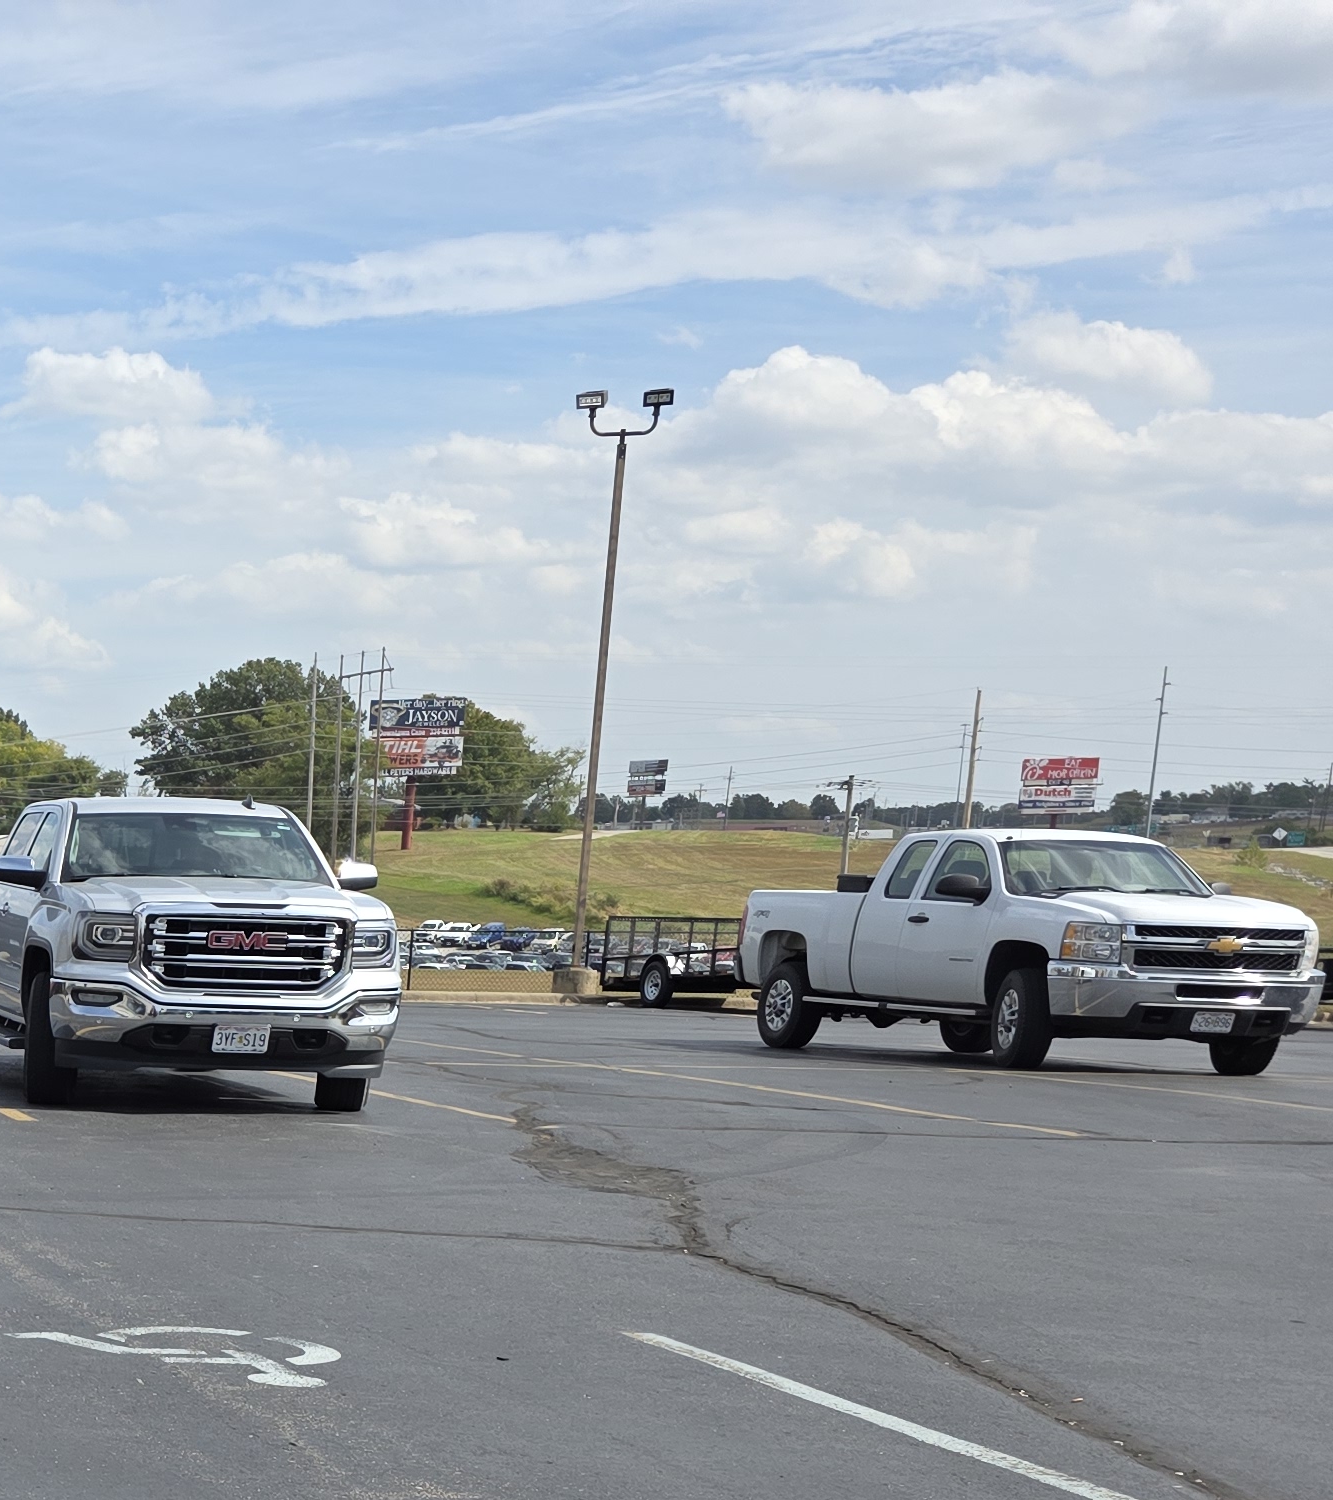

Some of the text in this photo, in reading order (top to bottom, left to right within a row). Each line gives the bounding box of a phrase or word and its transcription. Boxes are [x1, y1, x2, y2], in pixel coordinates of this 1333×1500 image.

[405, 708, 459, 725] JAYSON
[383, 740, 422, 753] TIHL
[389, 755, 419, 765] WERS
[1064, 759, 1082, 767] EAT
[390, 768, 414, 776] PETERS
[414, 767, 451, 776] HARDWARE
[1048, 769, 1067, 778] MOR
[1034, 788, 1071, 797] Dutch
[208, 930, 288, 951] GMC
